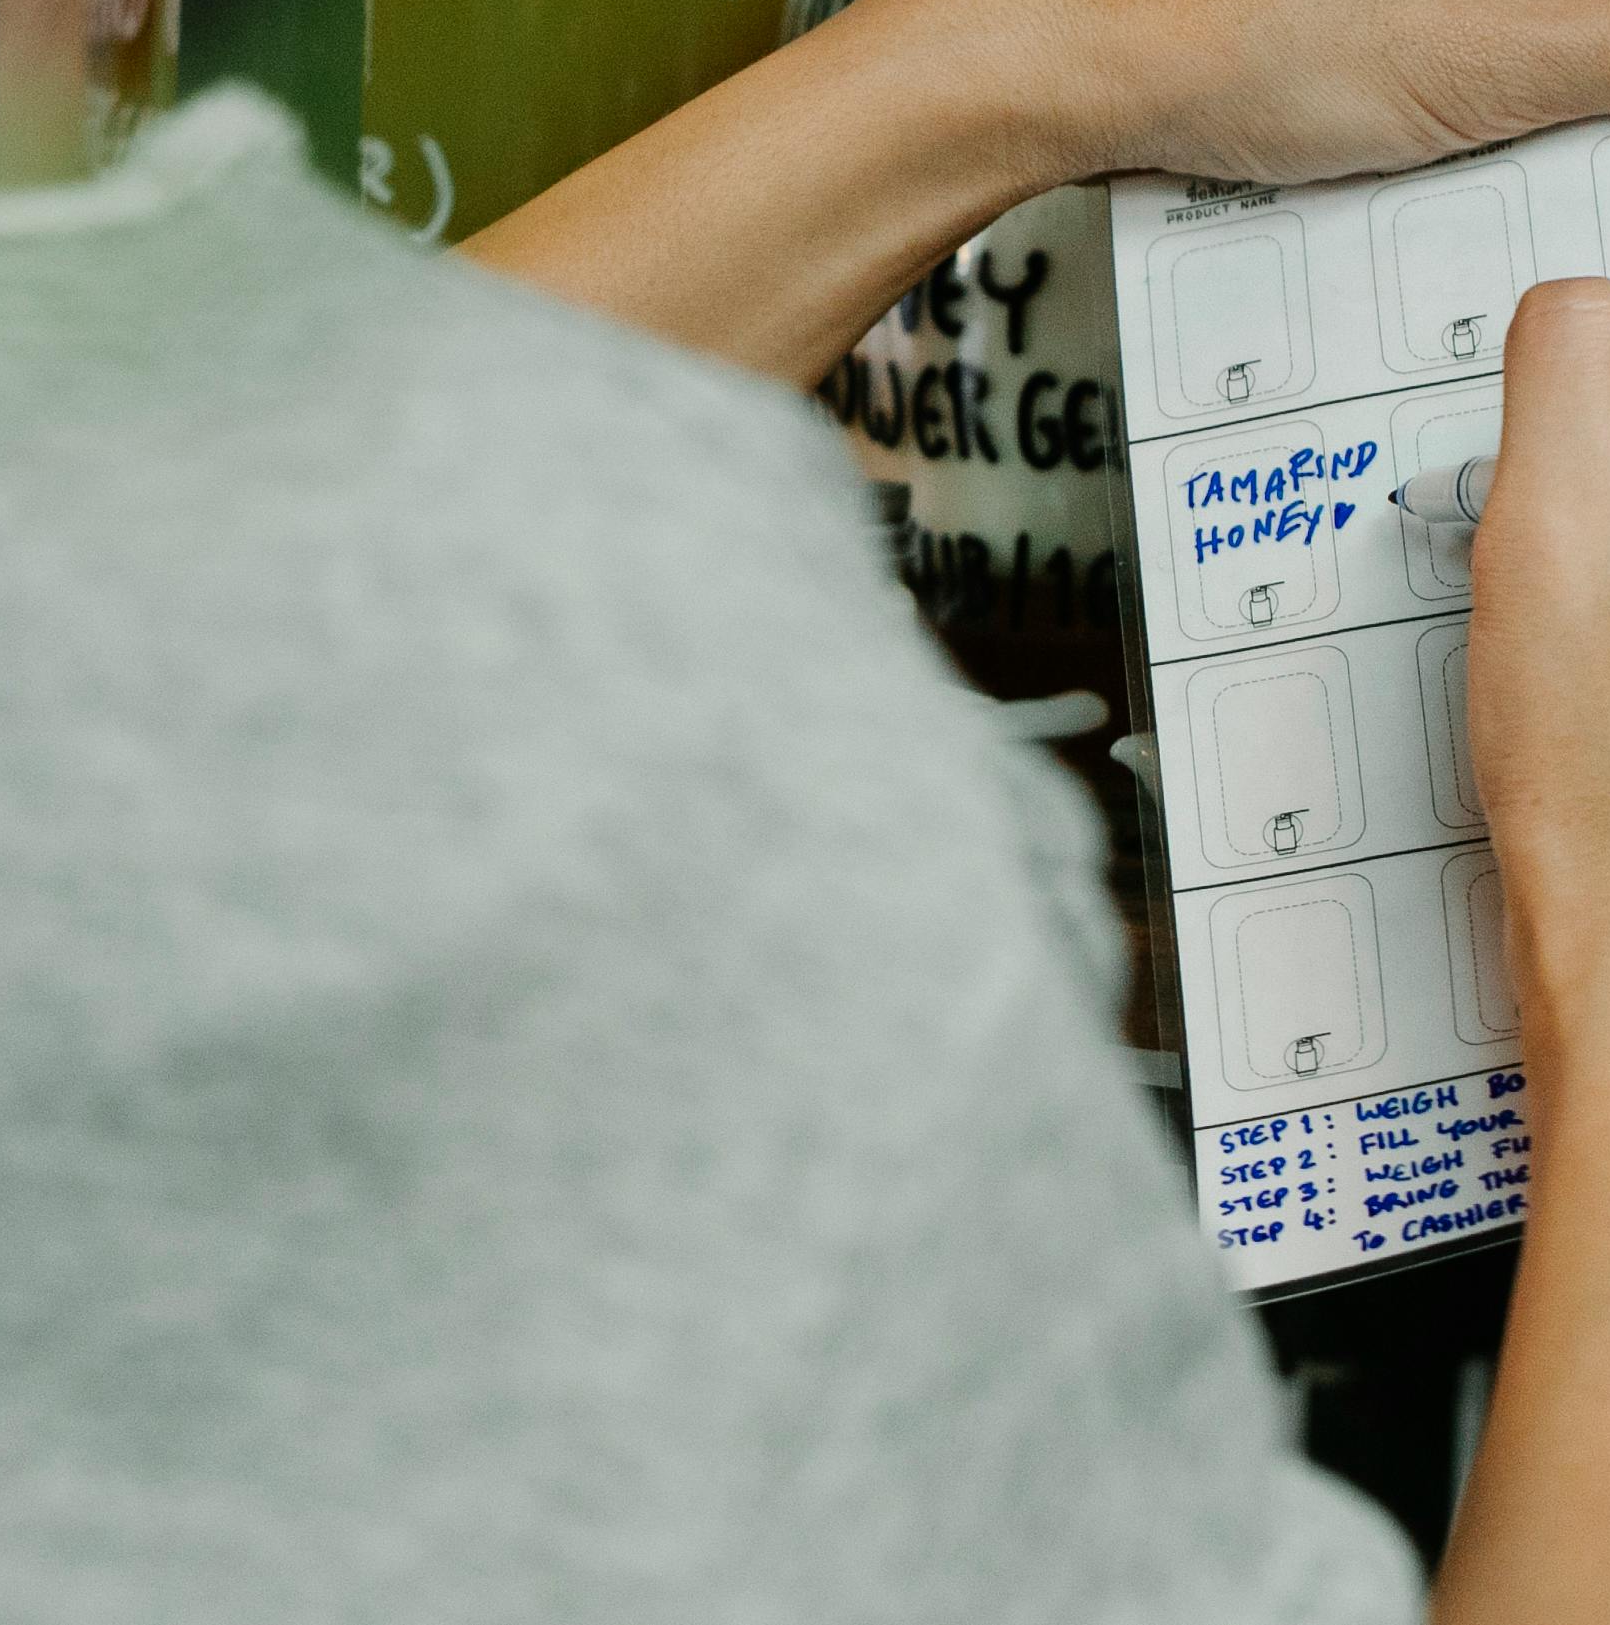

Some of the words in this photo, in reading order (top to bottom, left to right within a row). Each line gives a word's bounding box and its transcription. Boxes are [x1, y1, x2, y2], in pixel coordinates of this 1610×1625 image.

[1165, 203, 1231, 225] PRODUCT
[1241, 190, 1278, 211] NAME
[1178, 440, 1378, 509] TAMARIND
[1194, 499, 1325, 564] HONEY
[1220, 1119, 1288, 1154] STEP
[1355, 1084, 1459, 1122] WEIGH
[1220, 1155, 1287, 1186] STEP
[1358, 1127, 1420, 1156] FILL
[1436, 1108, 1525, 1142] YOUR
[1217, 1221, 1284, 1250] STEP
[1363, 1178, 1460, 1218] BRING
[1220, 1186, 1289, 1217] STEP
[1364, 1148, 1465, 1183] WEIGH
[1401, 1192, 1529, 1243] CASHIER
